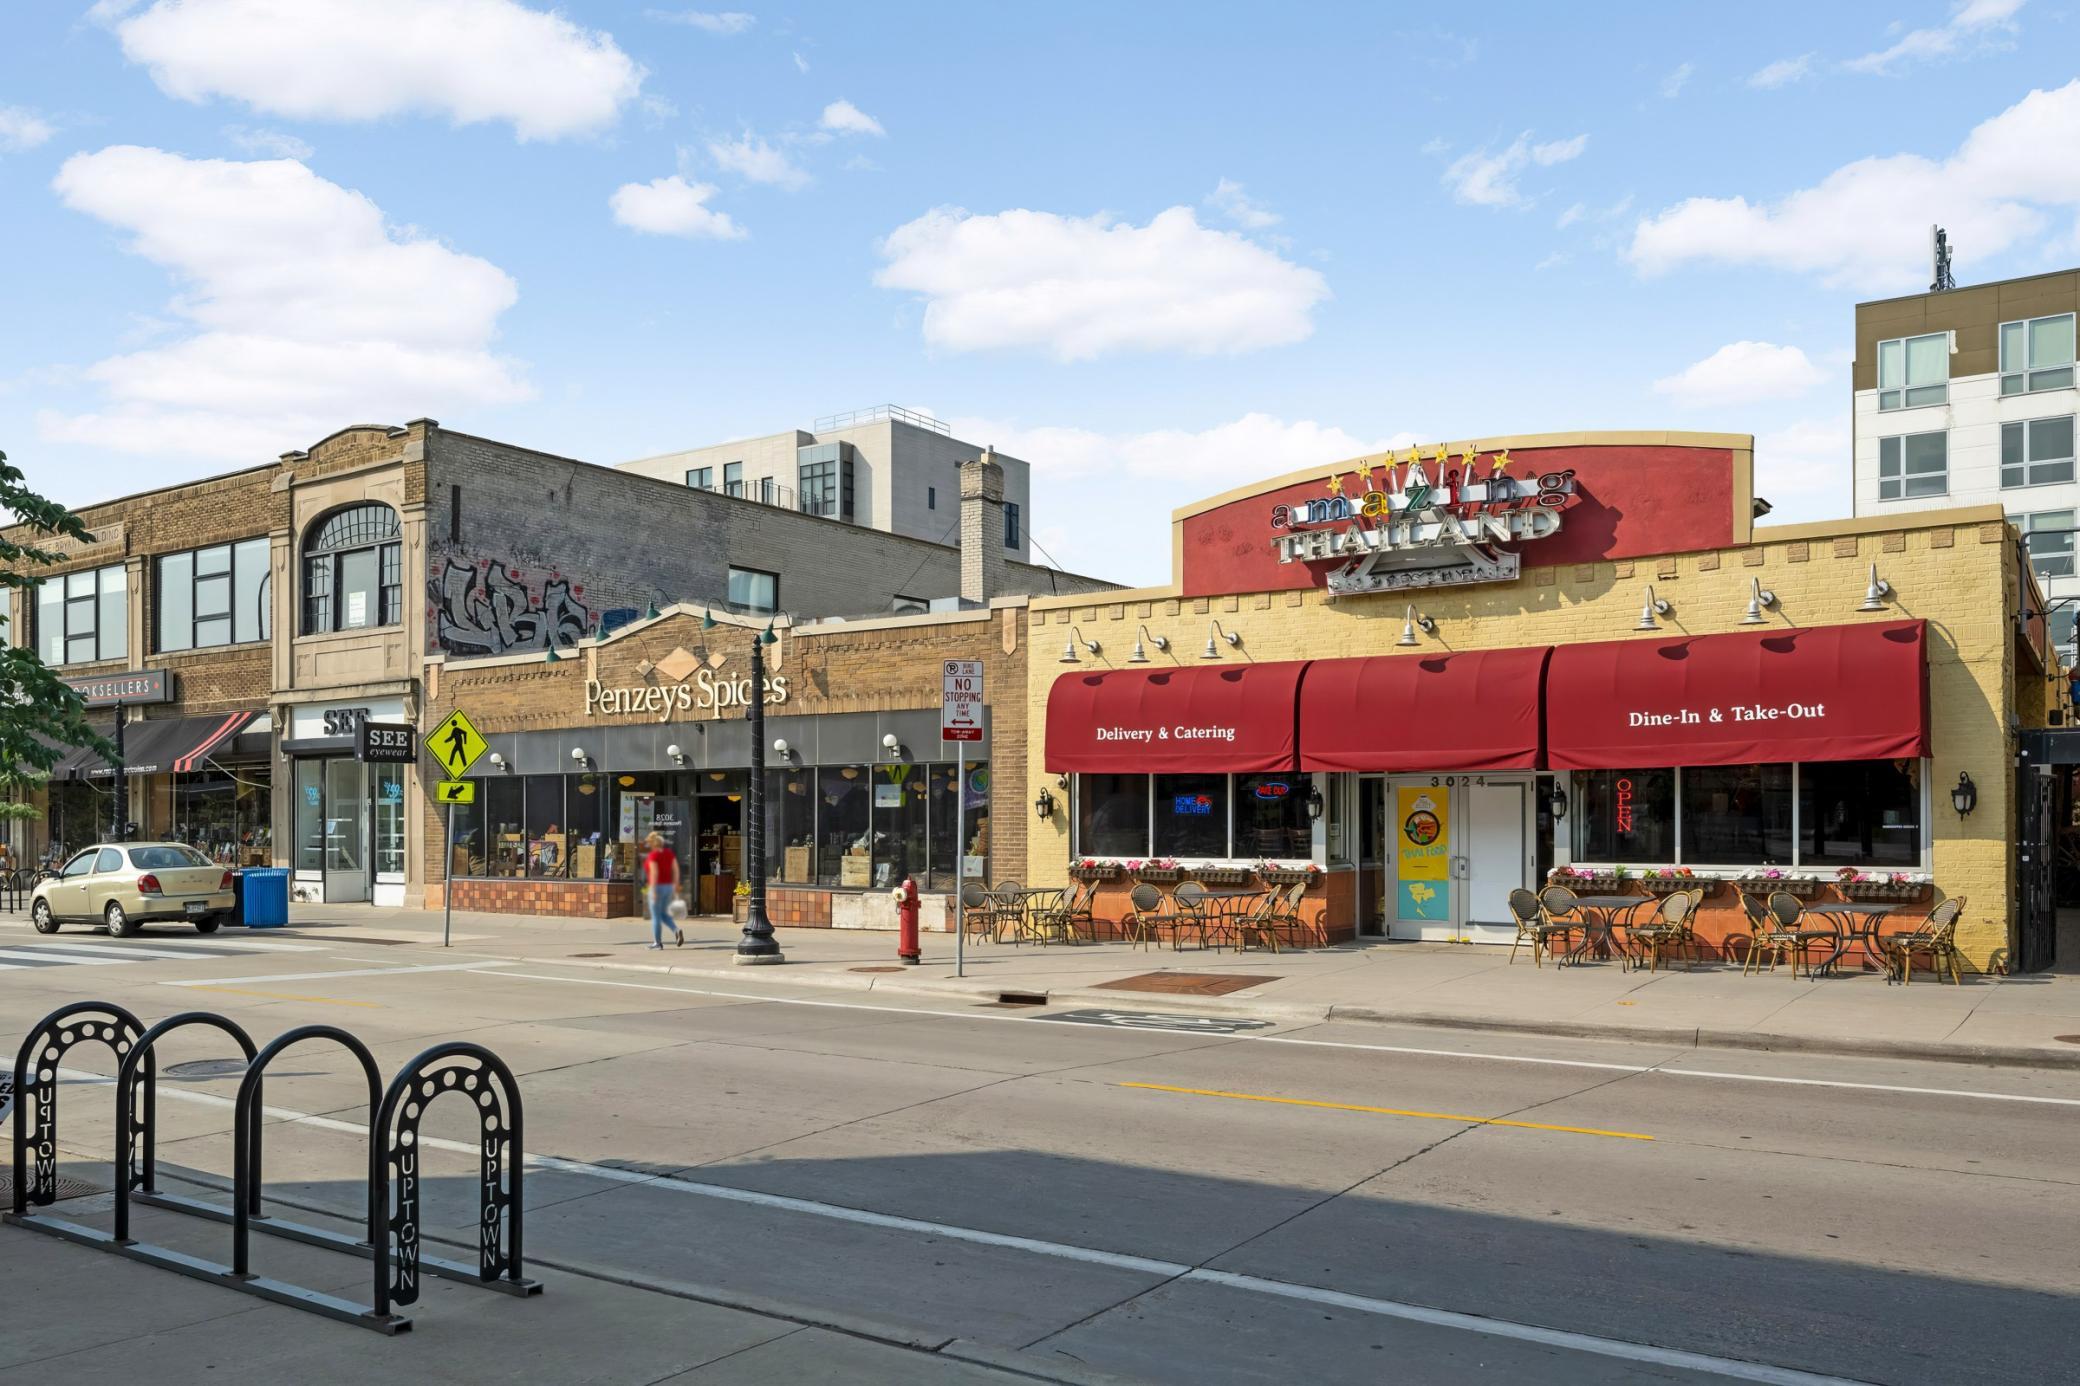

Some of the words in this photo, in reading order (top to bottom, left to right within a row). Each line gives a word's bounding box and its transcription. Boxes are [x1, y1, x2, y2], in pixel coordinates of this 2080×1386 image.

[1271, 468, 1576, 529] amazing
[1271, 505, 1563, 564] THAILAND
[955, 678, 971, 690] NO
[584, 679, 692, 722] Penzeys
[945, 691, 980, 702] STOPPING
[956, 709, 969, 717] TIME
[1629, 709, 1701, 727] Dine-In
[1708, 708, 1723, 723] &
[1730, 702, 1826, 722] Take-Out
[369, 729, 408, 747] SEE
[1096, 727, 1153, 743] Delivery
[1158, 726, 1169, 739] &
[1174, 725, 1236, 742] Catering
[369, 747, 408, 758] eyewear
[1431, 776, 1485, 787] 3024
[1175, 796, 1197, 805] HOME
[1175, 804, 1211, 814] DELIVERY
[1616, 778, 1632, 832] OPEN
[482, 1137, 500, 1269] UPTOWN
[399, 1153, 418, 1290] UPTOWN
